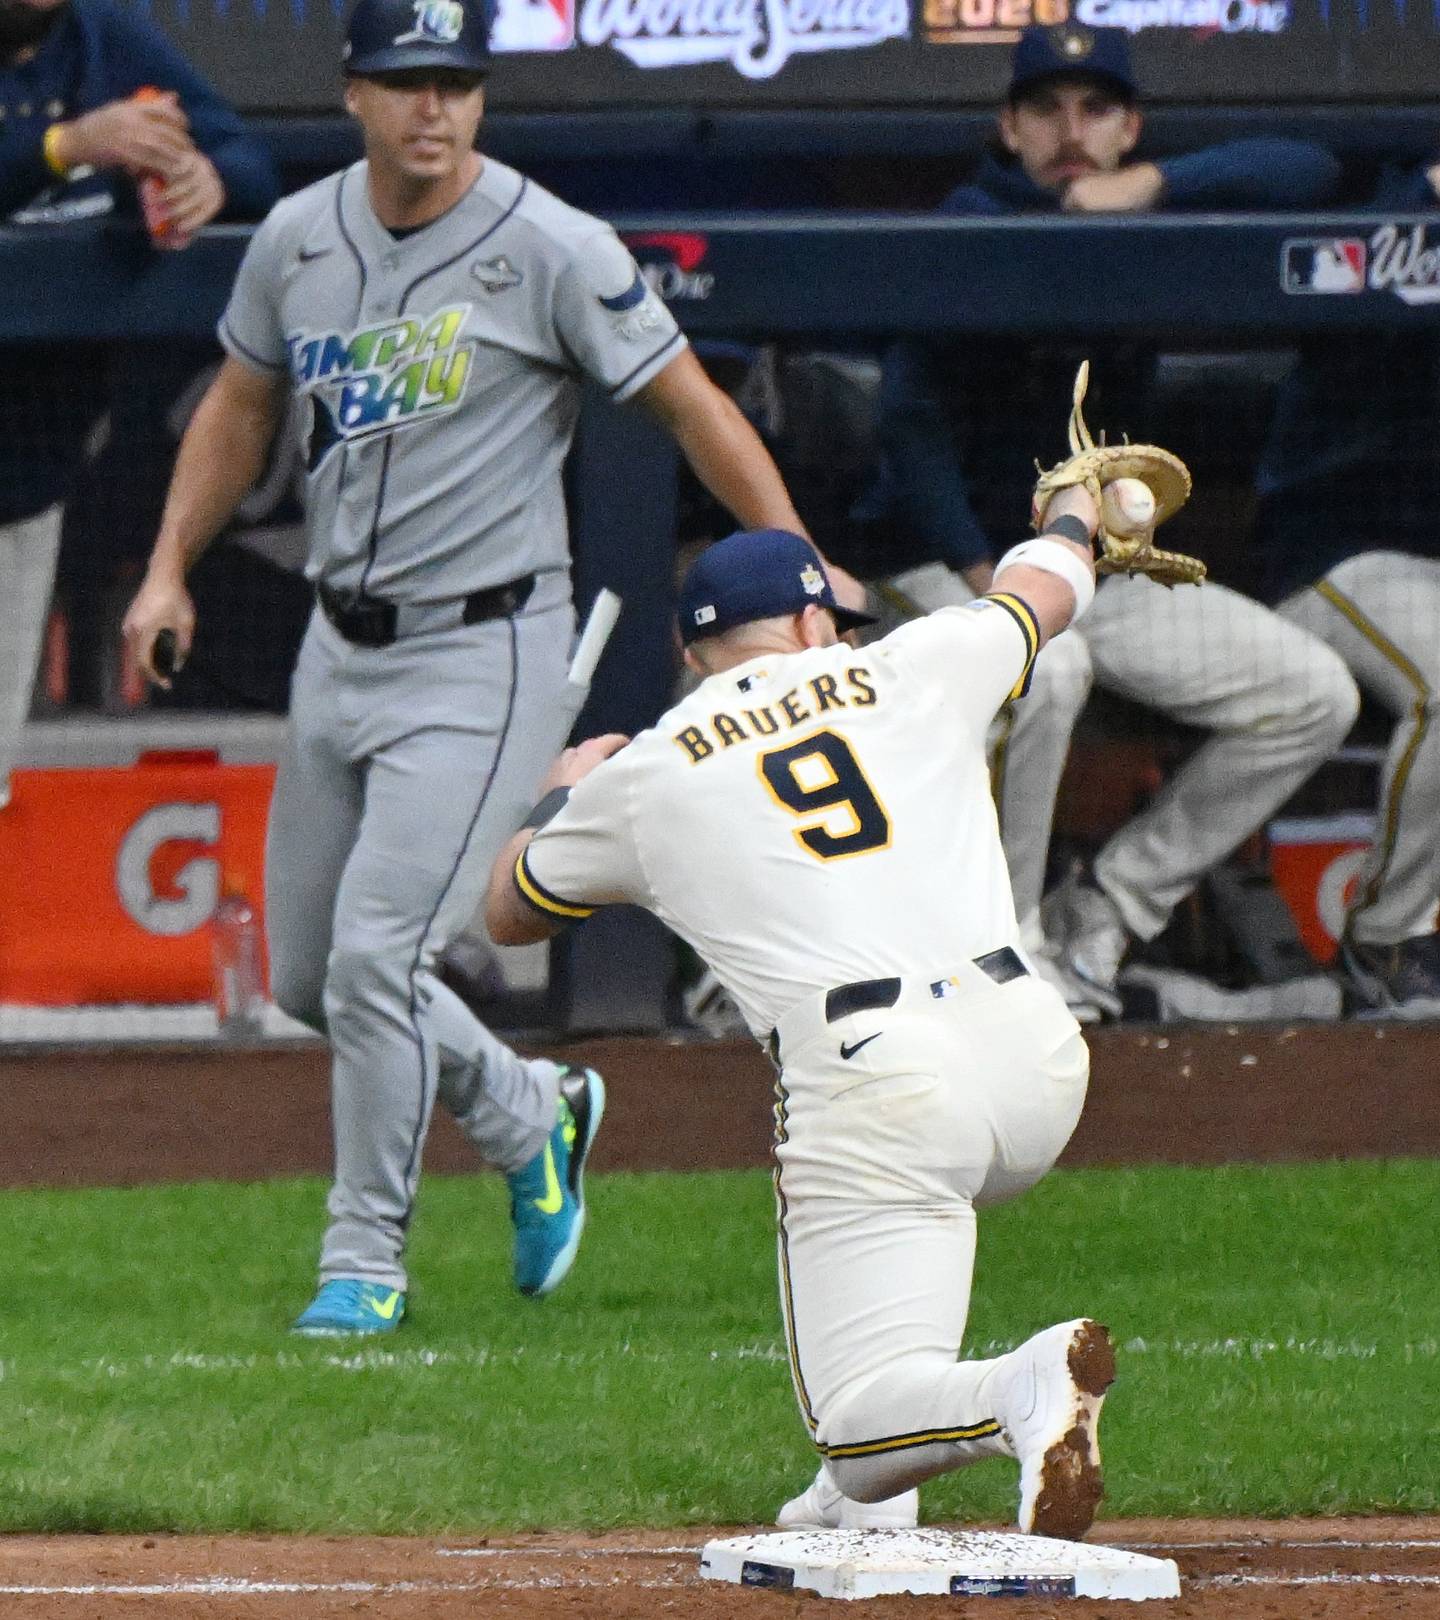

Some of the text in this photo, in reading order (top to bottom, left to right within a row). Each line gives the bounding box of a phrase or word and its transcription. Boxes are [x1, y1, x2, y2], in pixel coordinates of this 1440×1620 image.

[336, 342, 477, 436] BAY
[673, 667, 879, 766] BAUERS
[756, 726, 893, 864] 9
[116, 803, 221, 936] G
